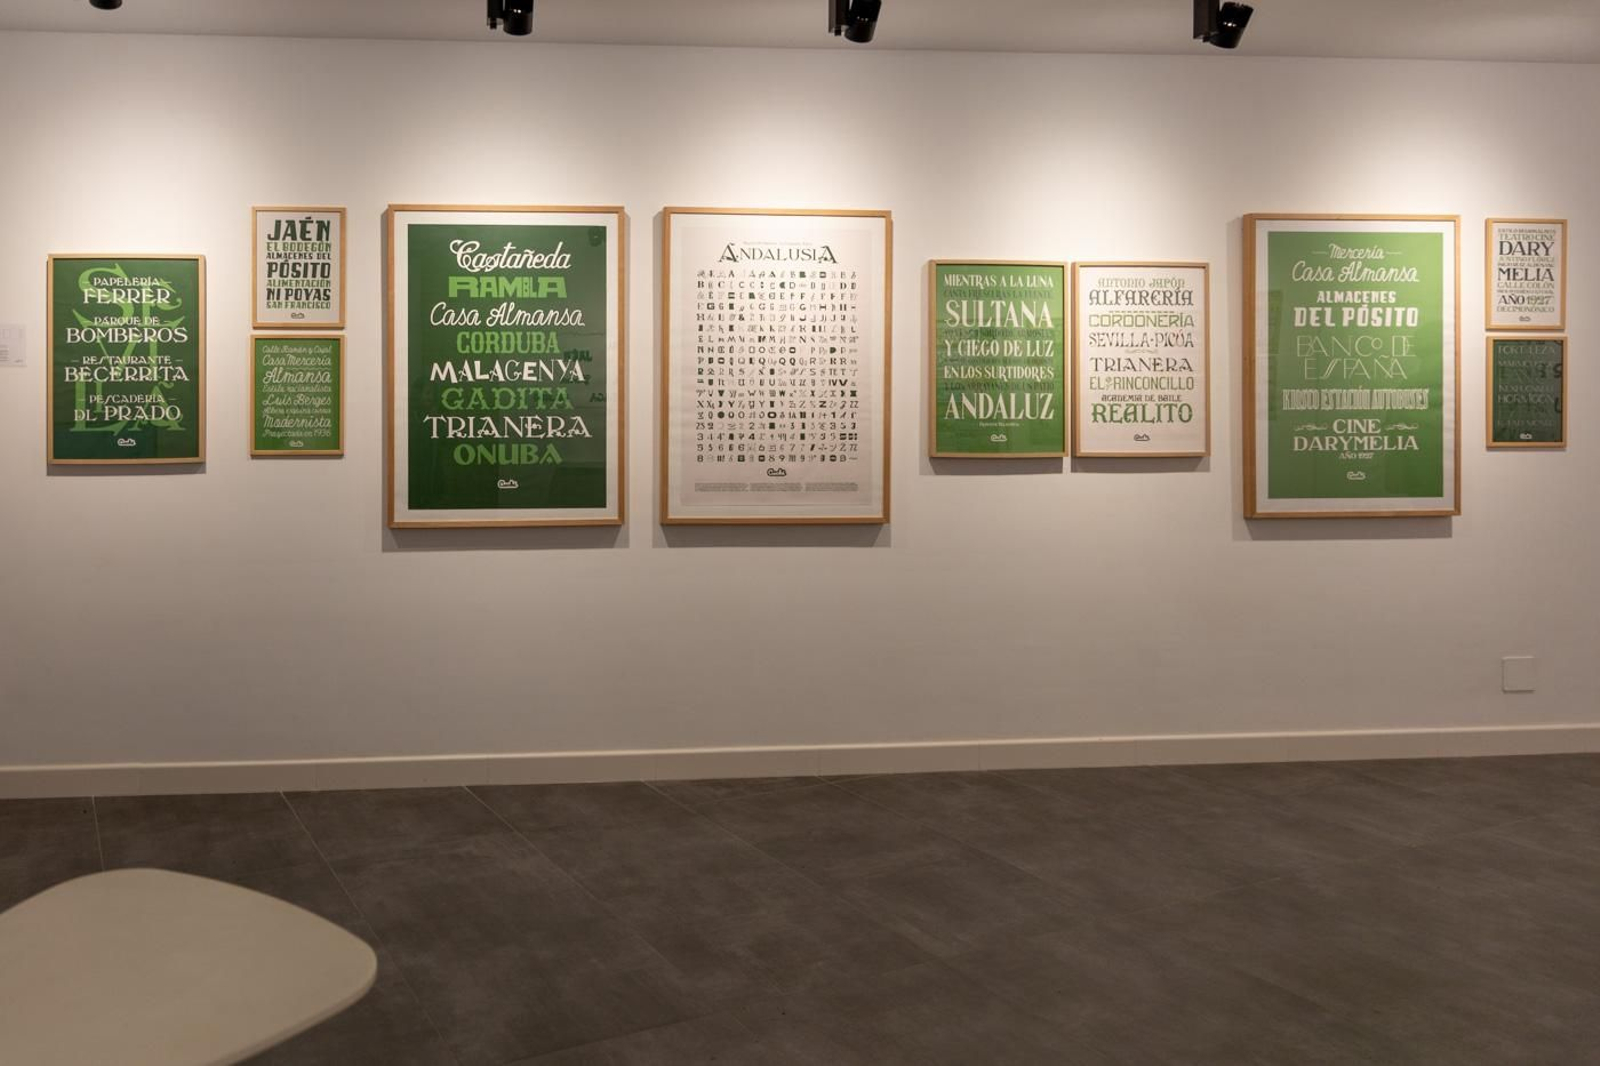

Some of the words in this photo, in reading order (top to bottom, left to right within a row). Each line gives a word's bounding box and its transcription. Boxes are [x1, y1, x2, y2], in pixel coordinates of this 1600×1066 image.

[267, 216, 331, 242] JAÉN
[266, 242, 281, 252] EL
[1328, 243, 1386, 260] Mercería
[1499, 241, 1555, 256] DARY
[266, 252, 313, 260] ALMACENES
[316, 252, 331, 260] DEL
[449, 239, 572, 272] Castañeda
[266, 259, 331, 279] PÓSITO
[1292, 260, 1336, 283] Casa
[1337, 261, 1420, 283] Almansa
[1498, 268, 1555, 281] MELIA
[93, 275, 160, 286] PAPELERÍA
[448, 276, 567, 298] RAMBLA
[943, 273, 997, 289] MIENTRAS
[999, 275, 1008, 288] A
[1009, 275, 1024, 288] LA
[1026, 274, 1055, 288] LUNA
[1097, 277, 1146, 288] ANTONIO
[83, 288, 170, 304] FERRER
[266, 288, 281, 301] NI
[284, 288, 331, 301] POYAS
[1088, 288, 1194, 306] ALFARERÍA
[1316, 290, 1396, 304] ALMACENES
[1498, 293, 1525, 305] AÑO
[1526, 295, 1555, 305] 1927
[266, 301, 284, 309] SAN
[285, 301, 331, 309] FRANCISCO
[94, 316, 140, 326] PARQUE
[144, 316, 160, 326] DE
[430, 302, 481, 327] Casa
[486, 303, 586, 327] Almansa
[944, 299, 1055, 328] SULTANA
[1089, 313, 1195, 328] CORDONERÍA
[1293, 307, 1337, 328] DEL
[1342, 303, 1419, 328] PÓSITO
[66, 327, 189, 344] BOMBEROS
[456, 331, 560, 354] CORDUBA
[944, 339, 954, 357] Y
[957, 339, 999, 357] CIEGO
[1003, 339, 1023, 357] DE
[1026, 339, 1055, 358] LUZ
[1391, 335, 1418, 358] DE
[82, 355, 172, 366] RESTAURANTE
[262, 354, 286, 366] Casa
[1089, 357, 1194, 372] TRIANERA
[1304, 354, 1408, 381] ESPAÑA
[64, 366, 190, 383] BECERRITA
[262, 367, 332, 384] Almansa
[430, 359, 586, 383] MALAGENYA
[944, 365, 960, 378] EN
[960, 365, 982, 379] LOS
[984, 365, 1055, 382] SURTIDORES
[1089, 376, 1105, 390] EL
[1114, 376, 1195, 391] RINCONCILLO
[89, 394, 165, 404] PESCADERÍA
[262, 394, 292, 406] Luis
[441, 387, 574, 410] GADITA
[944, 392, 1055, 420] ANDALUZ
[1101, 394, 1142, 402] ACADEMIA
[1145, 394, 1156, 402] DE
[1157, 394, 1183, 402] BAILE
[104, 405, 181, 422] PRADO
[263, 414, 332, 428] Modernista
[1091, 403, 1194, 424] REALITO
[423, 415, 593, 439] TRIANERA
[1333, 418, 1381, 434] CINE
[1293, 435, 1420, 451] DARYMELIA
[454, 443, 562, 465] ONUBA
[1339, 451, 1357, 459] AÑO
